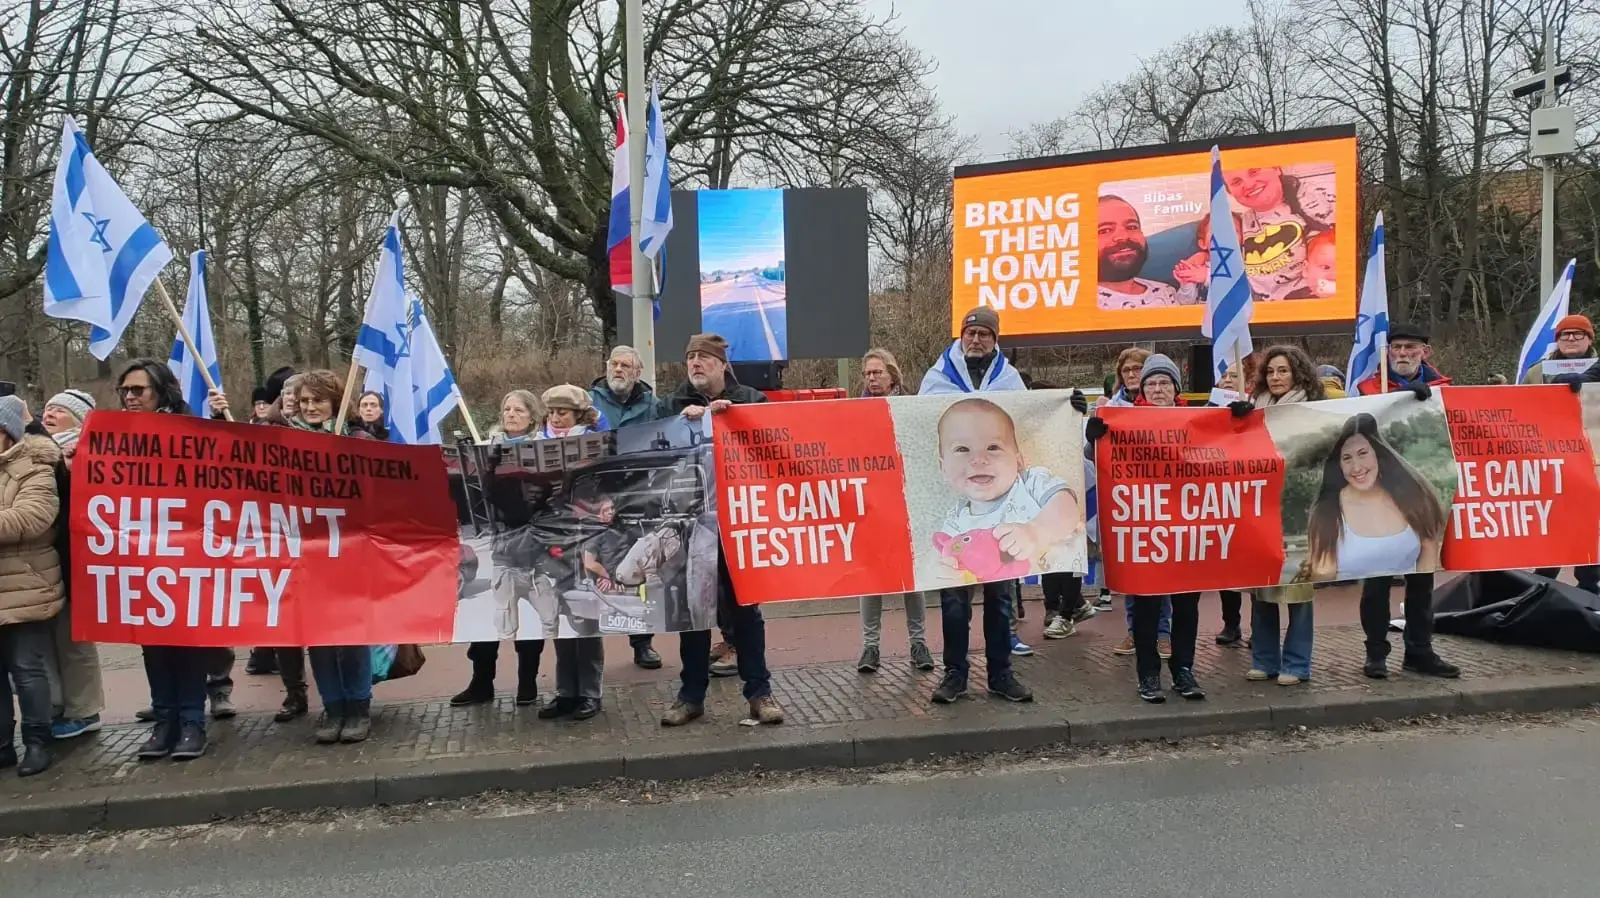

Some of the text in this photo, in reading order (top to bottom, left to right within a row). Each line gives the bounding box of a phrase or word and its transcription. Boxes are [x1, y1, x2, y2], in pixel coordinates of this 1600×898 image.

[965, 193, 1079, 228] BRING
[1143, 191, 1183, 203] Bibas
[1154, 201, 1202, 214] Family
[980, 222, 1079, 254] THEM
[964, 250, 1079, 284] HOME
[978, 279, 1080, 310] NOW
[1446, 409, 1466, 424] DED
[1458, 425, 1499, 440] ISRAELI
[89, 430, 162, 458] NAAMA
[169, 435, 224, 462] LEVY,
[230, 439, 256, 465] AN
[262, 443, 333, 474] ISRAELI
[722, 430, 749, 446] KFIR
[1110, 430, 1155, 445] NAAMA
[1455, 439, 1586, 456] STILL A HOSTAGE IN GAZA
[724, 448, 740, 463] AN
[744, 445, 791, 463] ISRAELI
[725, 456, 896, 480] IS STILL A HOSTAGE IN GAZA
[1111, 447, 1127, 462] AN
[1131, 446, 1179, 461] ISRAELI
[1111, 458, 1278, 479] IS STILL A HOSTAGE IN GAZA
[87, 460, 361, 499] IS STILL A HOSTAGE IN GAZA
[1485, 459, 1564, 497] CAN'T
[728, 477, 867, 525] HE CAN'T
[1112, 479, 1268, 522] SHE CAN'T
[87, 495, 346, 558] SHE CAN'T
[1452, 500, 1552, 540] TESTIFY
[731, 522, 856, 570] TESTIFY
[1112, 524, 1236, 563] TESTIFY
[87, 565, 291, 627] TESTIFY
